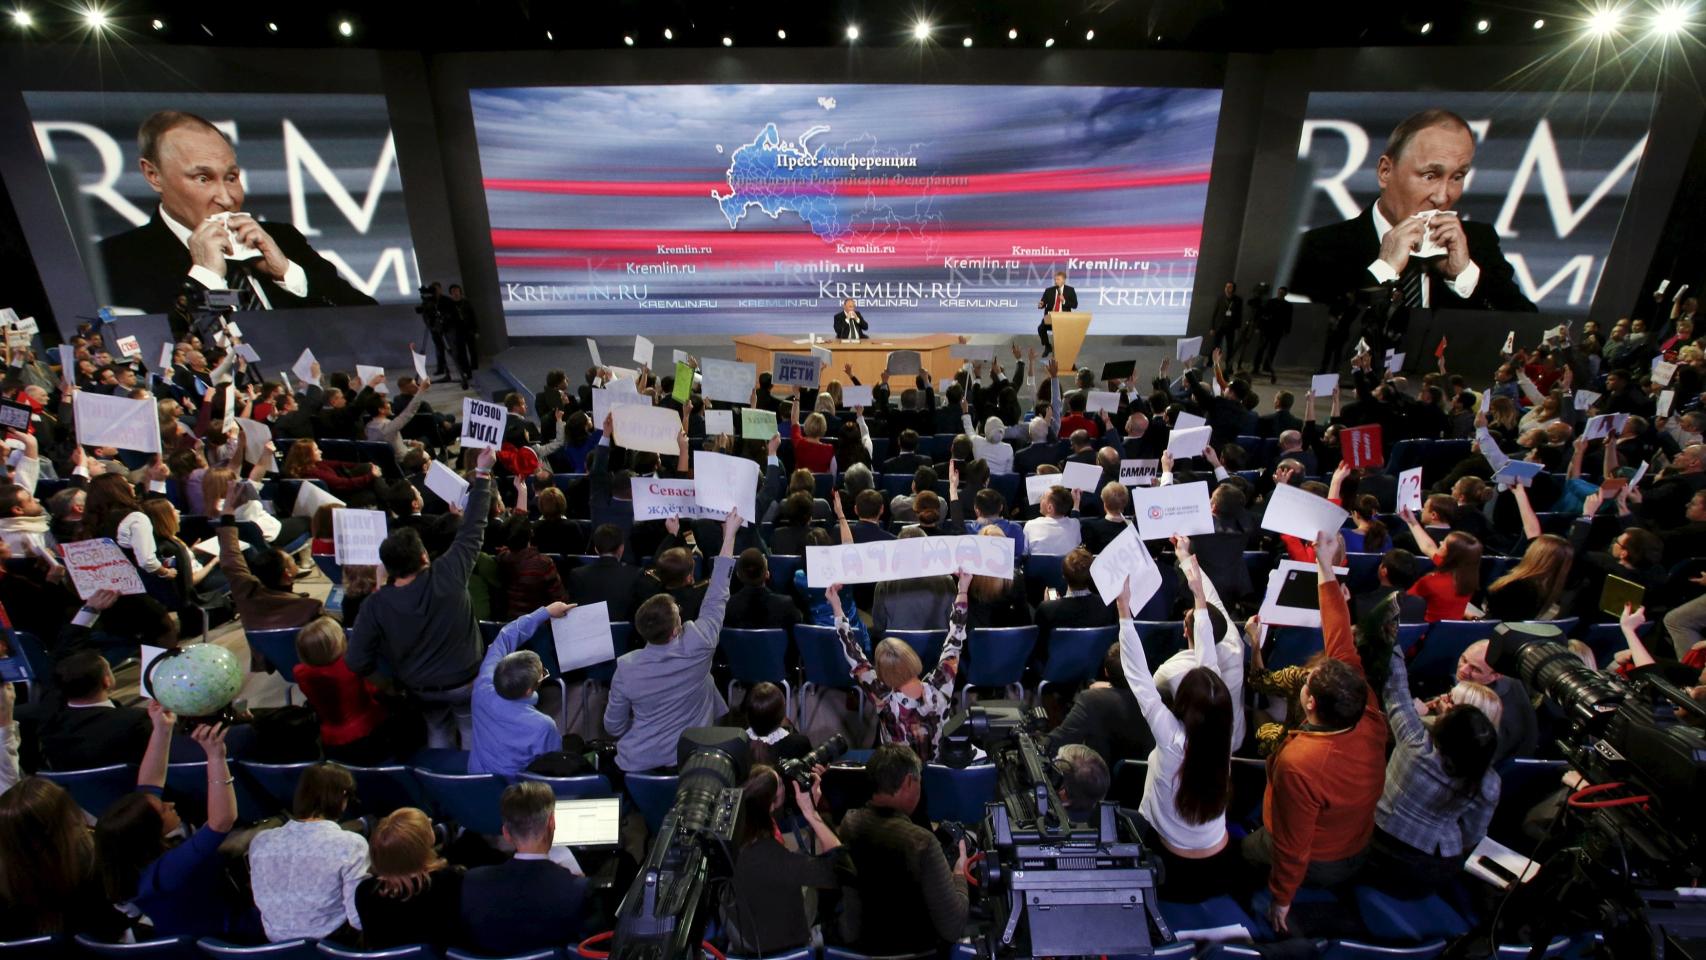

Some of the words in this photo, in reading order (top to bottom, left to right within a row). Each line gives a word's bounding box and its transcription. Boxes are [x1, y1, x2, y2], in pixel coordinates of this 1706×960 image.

[776, 154, 918, 171] Пресс-конференция
[656, 244, 712, 255] Kremlin.ru
[836, 243, 896, 254] Kremlin.ru
[1011, 245, 1070, 257] Kremlin.ru
[1183, 247, 1199, 258] Kr
[626, 262, 696, 275] Kremlin.ru
[774, 261, 864, 273] Kremlin.ru
[943, 256, 1020, 269] Kremlin.ru
[1067, 257, 1150, 270] Kremlin.ru
[506, 283, 649, 302] KREMLIN.RU
[819, 279, 962, 299] KREMLIN.RU
[639, 300, 718, 309] KREMLIN.RU
[739, 299, 818, 308] KREMLIN.RU
[939, 298, 1018, 308] KREMLIN.RU
[778, 365, 814, 381] ДЕТИ
[469, 420, 498, 445] ТУЛА
[1120, 466, 1156, 478] САМАРА
[648, 503, 684, 515] ждёт
